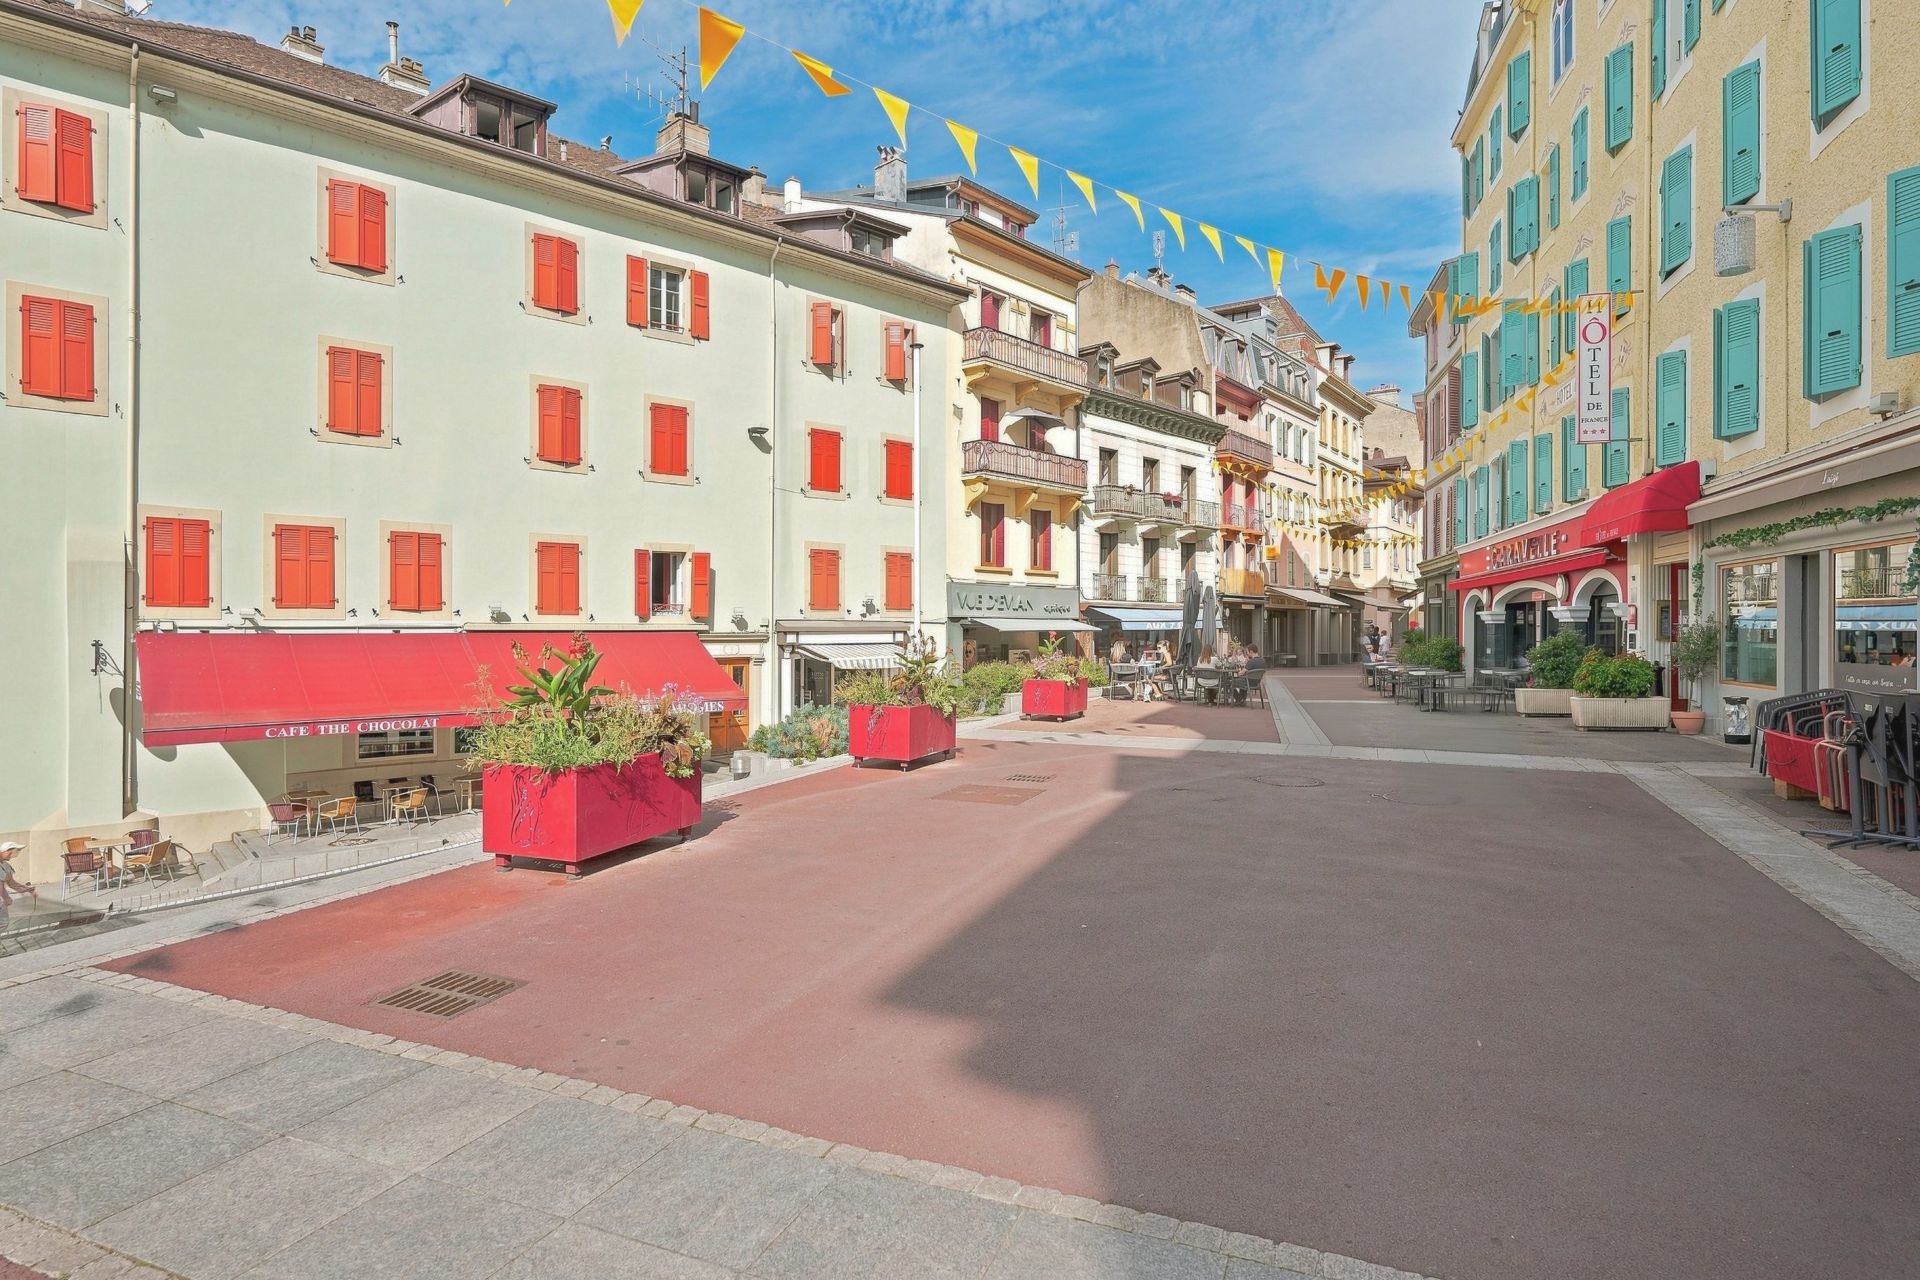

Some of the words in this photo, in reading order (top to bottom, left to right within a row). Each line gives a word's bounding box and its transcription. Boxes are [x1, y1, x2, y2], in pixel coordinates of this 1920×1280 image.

[1587, 402, 1602, 411] DE
[265, 726, 309, 739] CAFE
[318, 723, 350, 736] THE
[357, 717, 440, 732] CHOCOLAT
